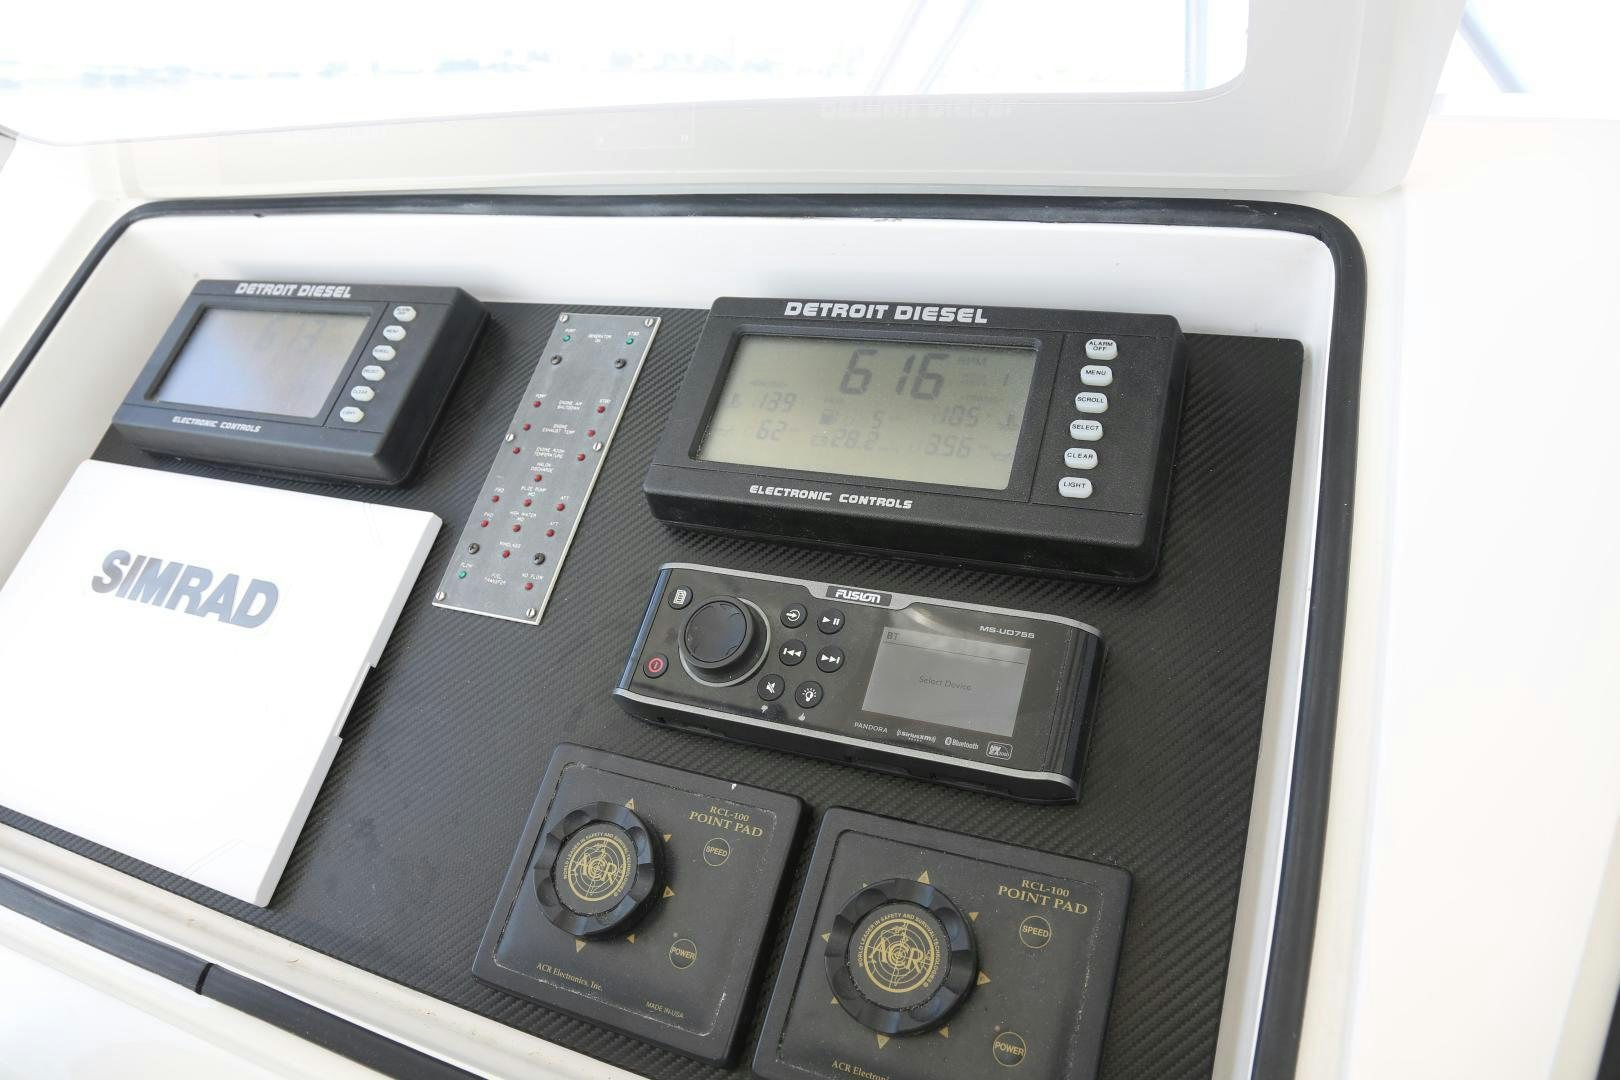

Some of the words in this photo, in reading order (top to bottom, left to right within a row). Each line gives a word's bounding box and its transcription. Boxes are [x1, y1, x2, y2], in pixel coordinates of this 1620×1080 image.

[235, 282, 297, 296] DETROIT
[298, 284, 352, 299] DIESEL
[784, 301, 890, 319] DETROIT
[894, 305, 988, 323] DIESEL
[1088, 340, 1114, 348] ALARM
[839, 349, 950, 401] 616
[1085, 369, 1107, 377] MENU
[1077, 396, 1105, 404] SCROLL
[172, 416, 219, 429] ELECTRONIC
[220, 421, 262, 433] CONTROLS
[1072, 423, 1100, 431] SELECT
[1066, 452, 1094, 460] CLEAR
[1063, 481, 1086, 489] LIGHT
[749, 484, 833, 501] ELECTRONIC
[838, 493, 913, 510] CONTROLS
[91, 549, 279, 629] SIMRAD
[835, 589, 881, 604] FUSION
[886, 631, 898, 642] BT
[919, 675, 943, 687] Select
[944, 679, 972, 691] Device
[854, 721, 888, 734] PANDORA
[952, 738, 979, 750] Bluetooth
[709, 805, 750, 822] RCL-100
[688, 811, 733, 831] POINT
[734, 822, 764, 838] PAD
[705, 845, 728, 858] SPEED
[1021, 879, 1070, 898] RCL-100
[997, 885, 1052, 907] POINT
[1053, 897, 1089, 915] PAD
[880, 912, 902, 921] SAFETY
[1022, 925, 1049, 938] SPEED
[671, 946, 696, 960] POWER
[536, 962, 552, 974] ACR
[590, 980, 603, 992] Inc.
[994, 1041, 1025, 1057] POWER
[831, 1060, 851, 1073] ACR
